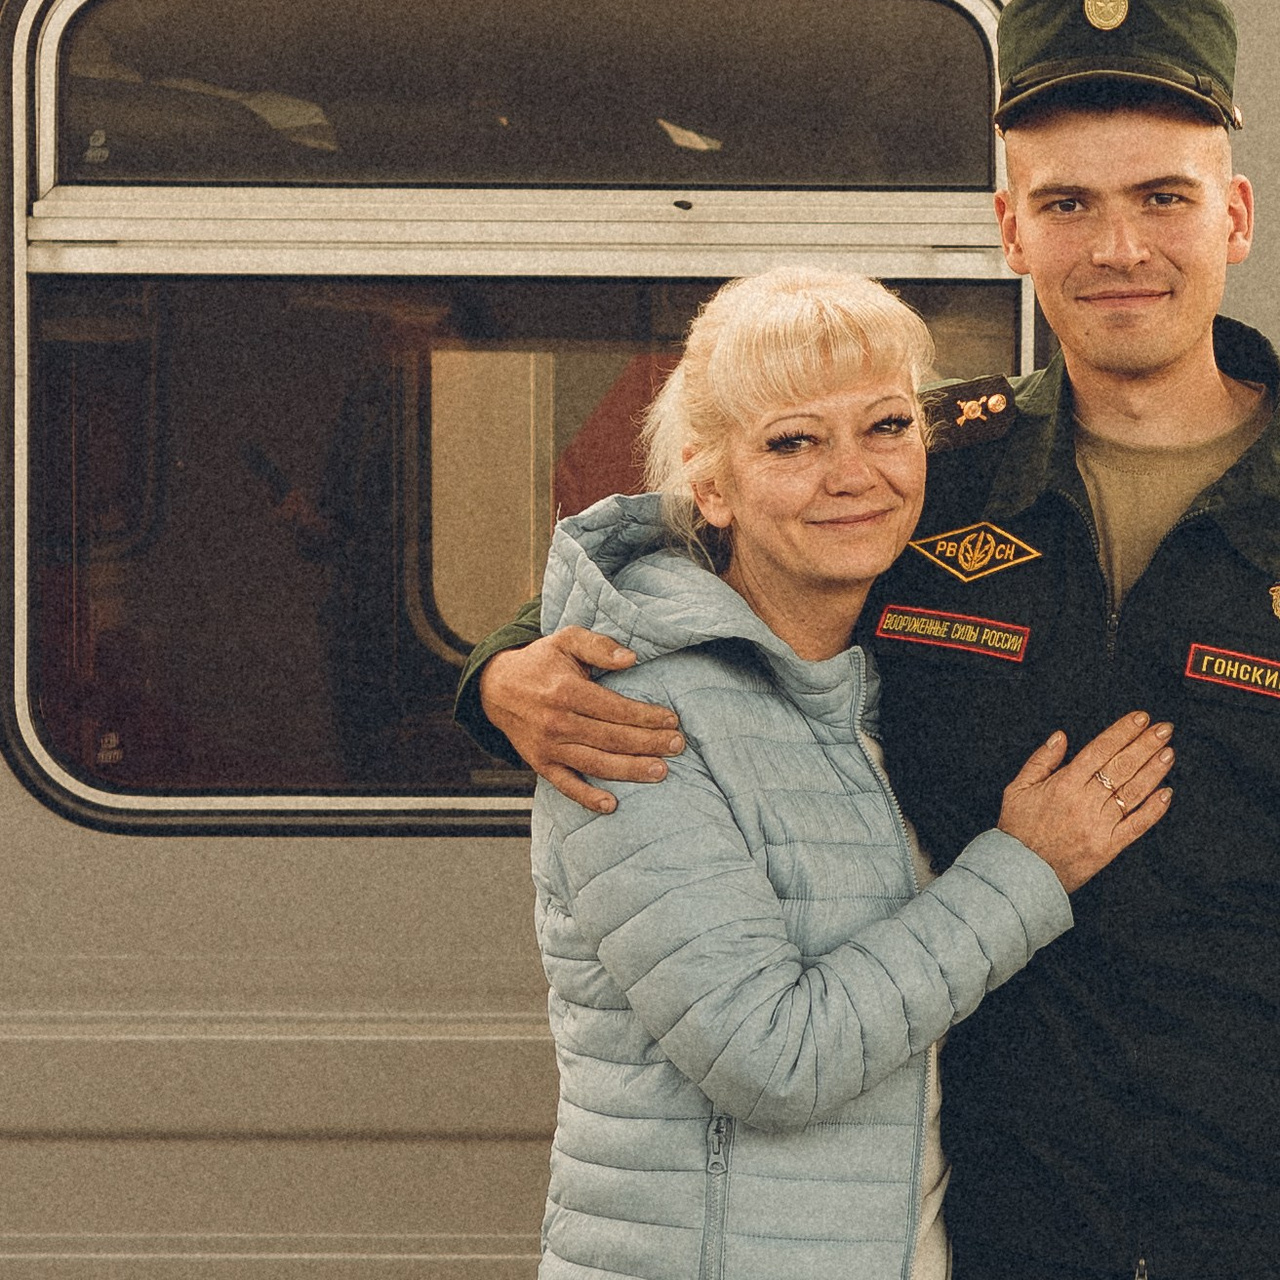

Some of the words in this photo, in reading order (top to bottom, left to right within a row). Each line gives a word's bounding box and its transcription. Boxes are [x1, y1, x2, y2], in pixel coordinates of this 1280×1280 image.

[882, 613, 951, 638] ВООРУЖЕННЫЕ
[951, 623, 980, 643] СИЛЫ
[980, 628, 1024, 652] РОССИИ
